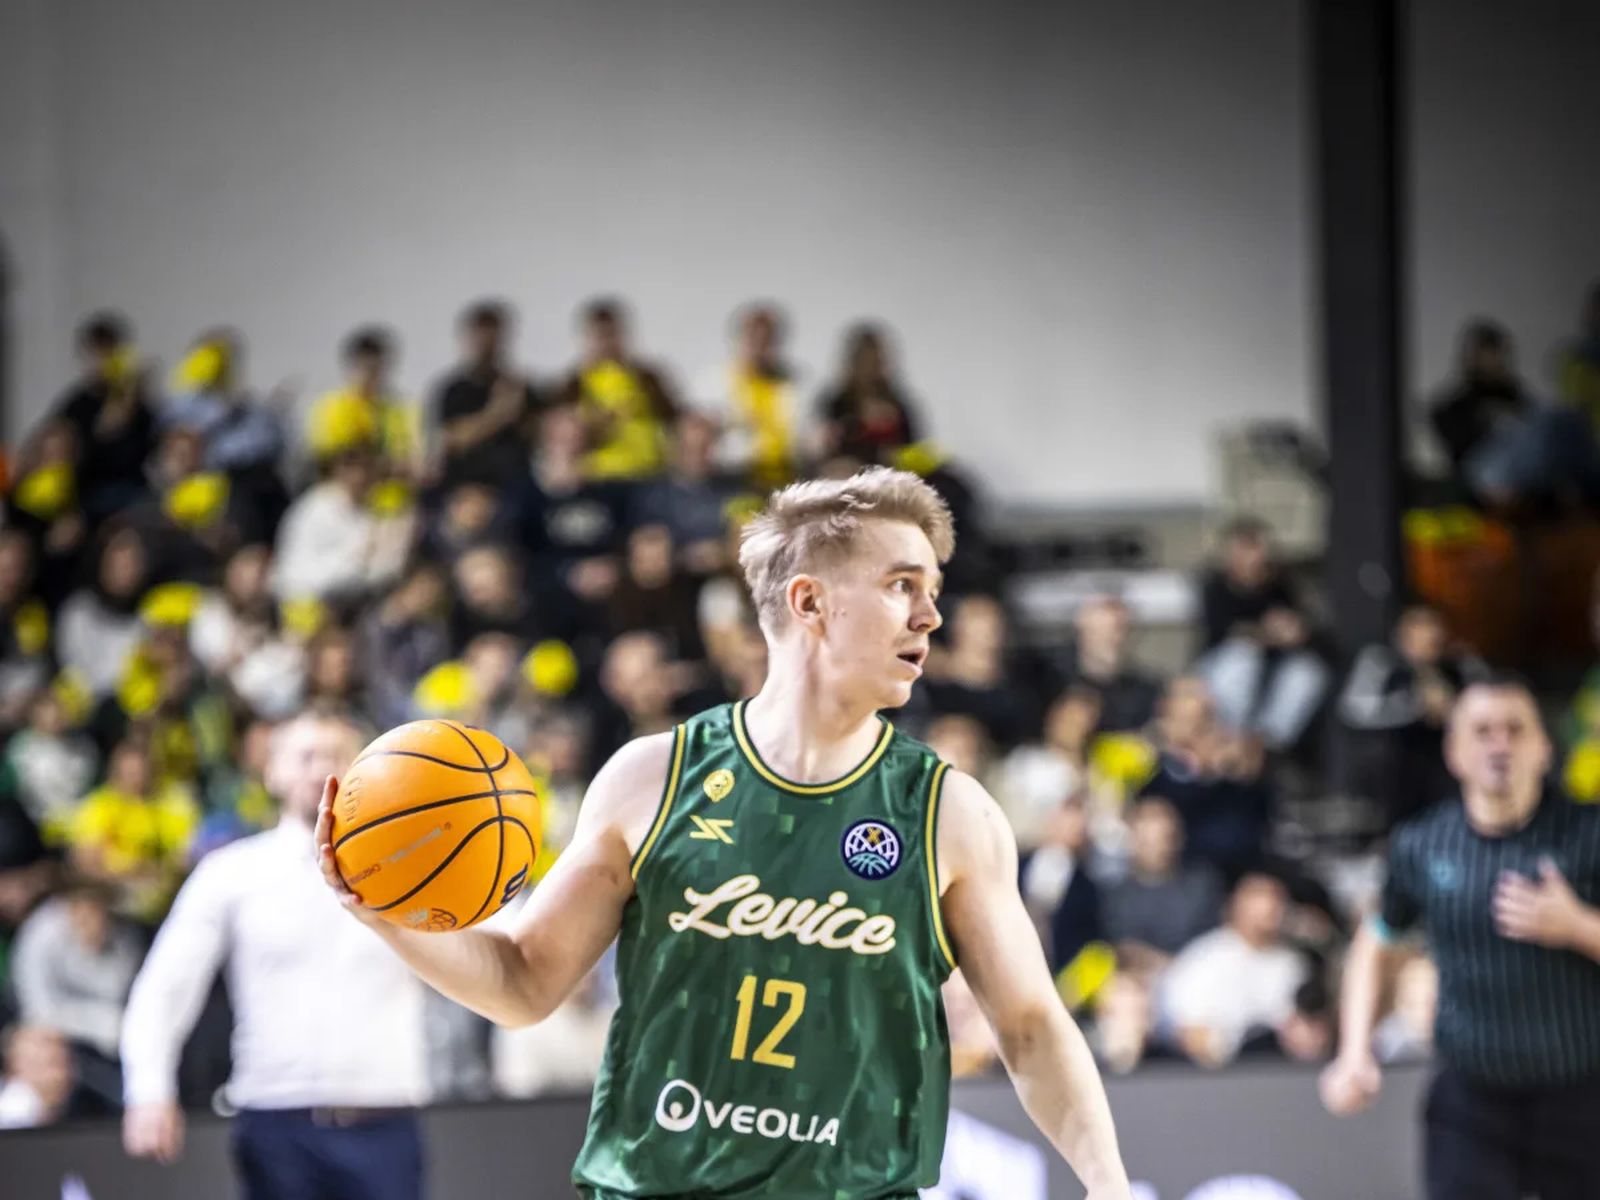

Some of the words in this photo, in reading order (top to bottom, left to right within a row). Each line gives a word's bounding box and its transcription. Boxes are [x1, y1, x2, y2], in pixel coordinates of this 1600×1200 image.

[668, 874, 897, 955] Levice
[730, 974, 807, 1069] 12
[703, 1099, 841, 1146] VEOLIA
